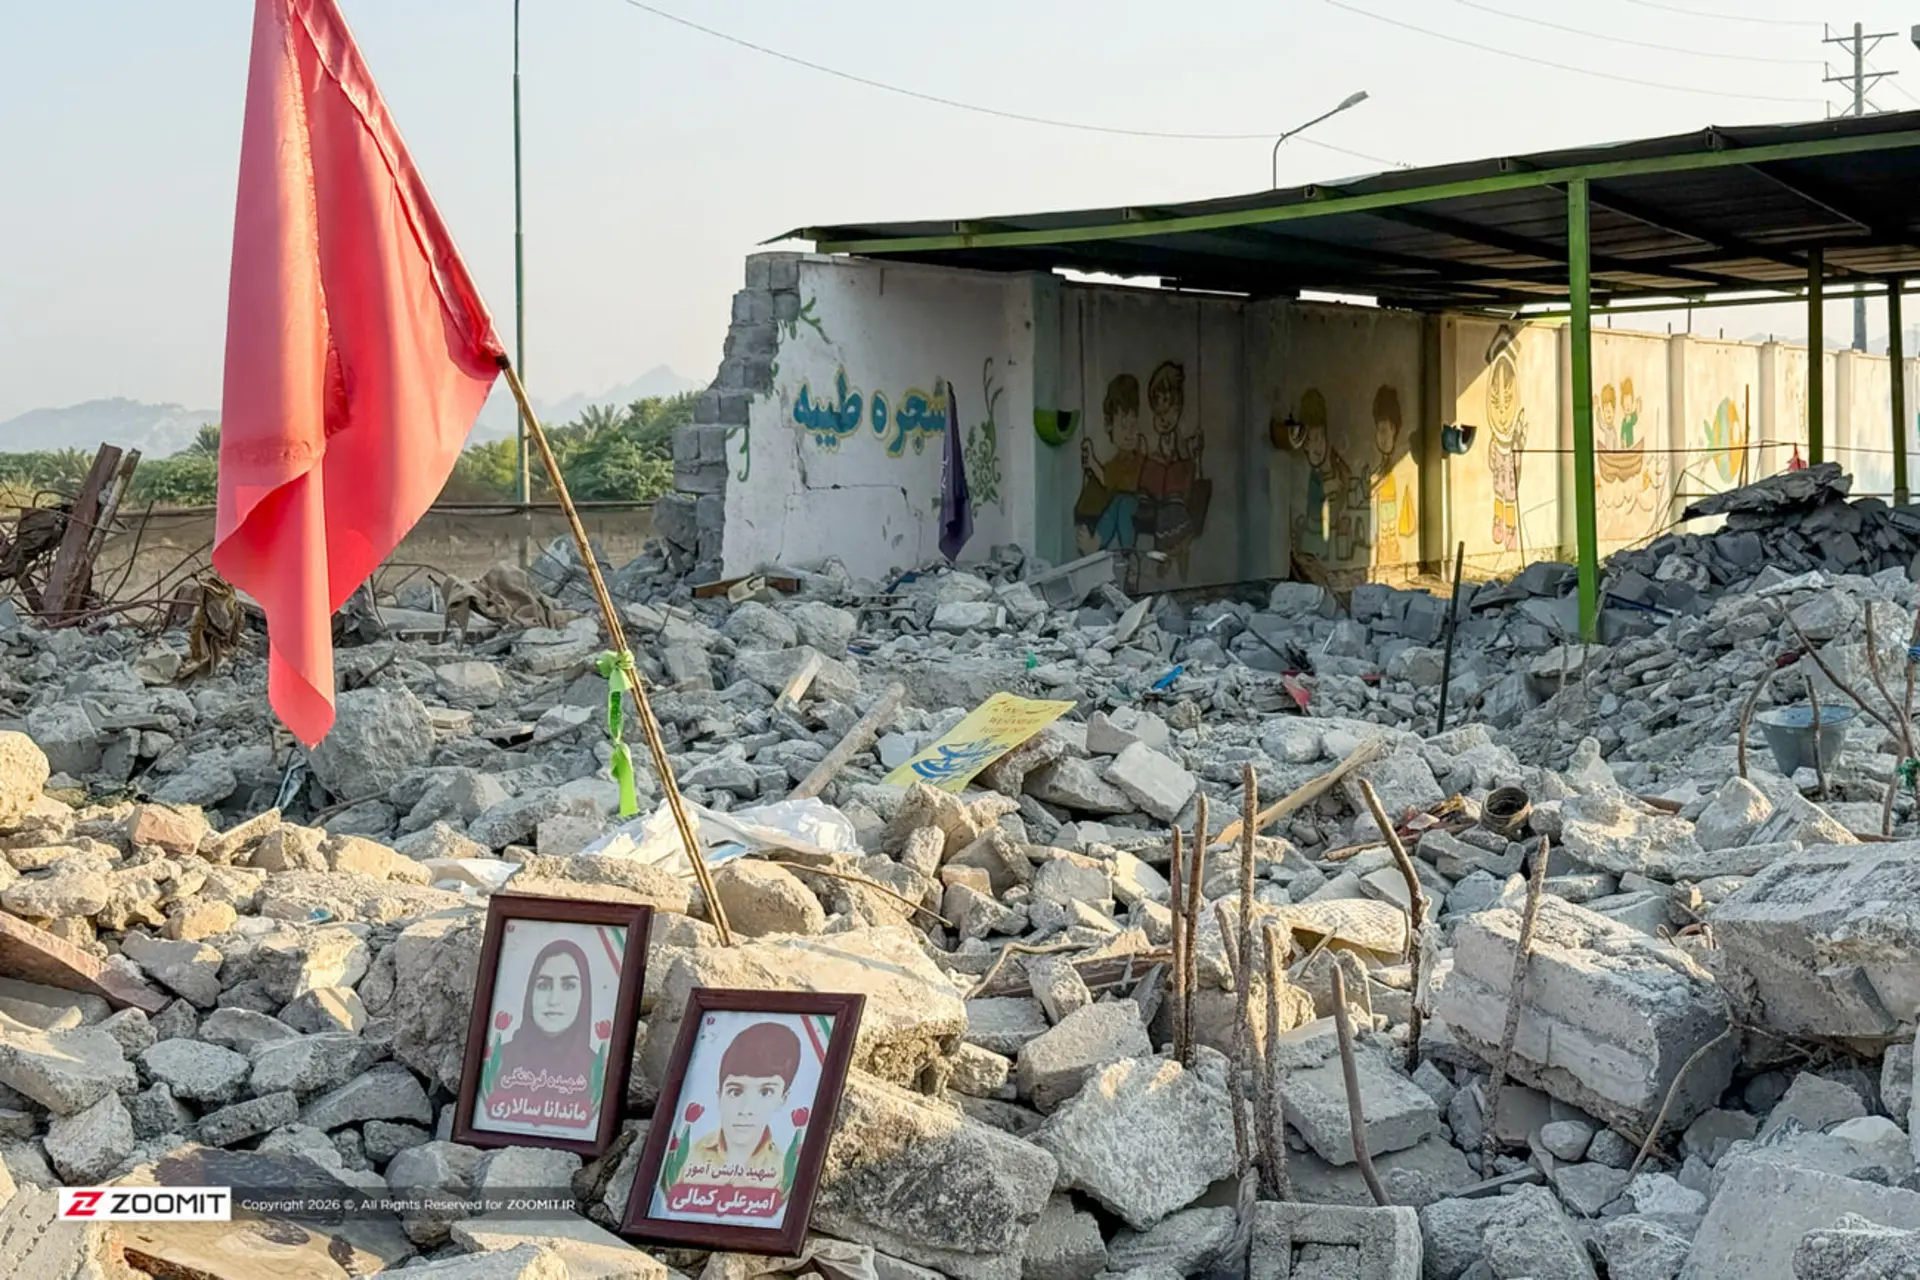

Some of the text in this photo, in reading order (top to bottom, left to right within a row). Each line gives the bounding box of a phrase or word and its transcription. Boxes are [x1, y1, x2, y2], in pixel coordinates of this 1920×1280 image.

[792, 363, 865, 453] طیبه
[500, 1066, 588, 1095] شهیده فرهنگی
[491, 1097, 588, 1121] ماندانا سالاری
[684, 1159, 778, 1181] شهید دانش آموز
[671, 1187, 719, 1210] کمالی
